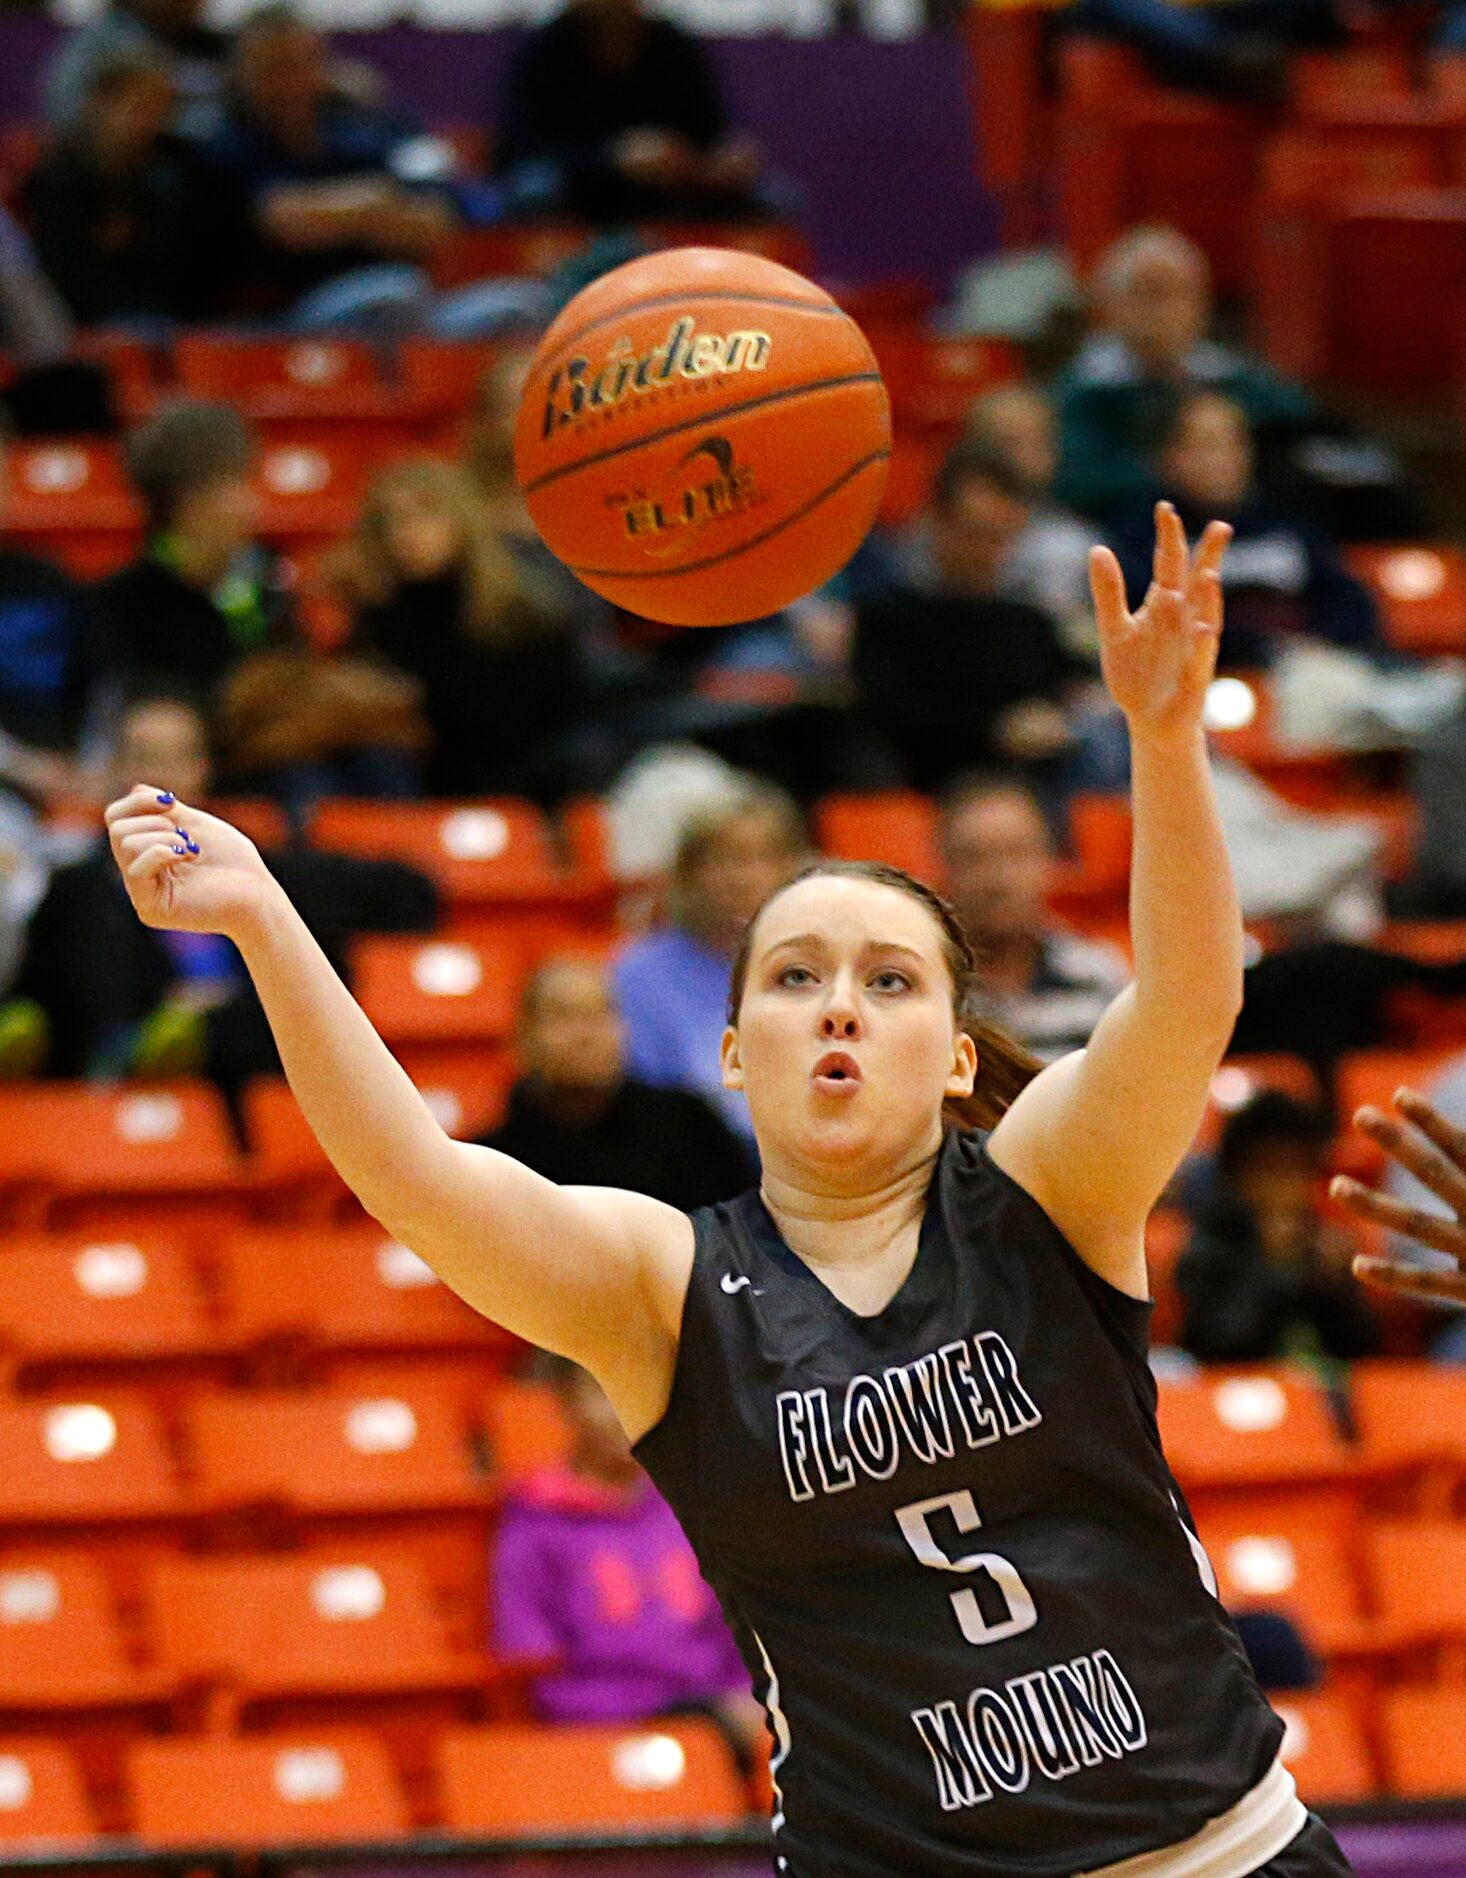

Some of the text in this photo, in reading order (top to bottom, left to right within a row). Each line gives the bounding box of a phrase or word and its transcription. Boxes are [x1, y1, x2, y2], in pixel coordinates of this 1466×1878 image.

[541, 315, 772, 442] Baden
[776, 1331, 1042, 1502] FLOWER
[893, 1489, 1040, 1646] 5
[911, 1649, 1149, 1812] MOUND
